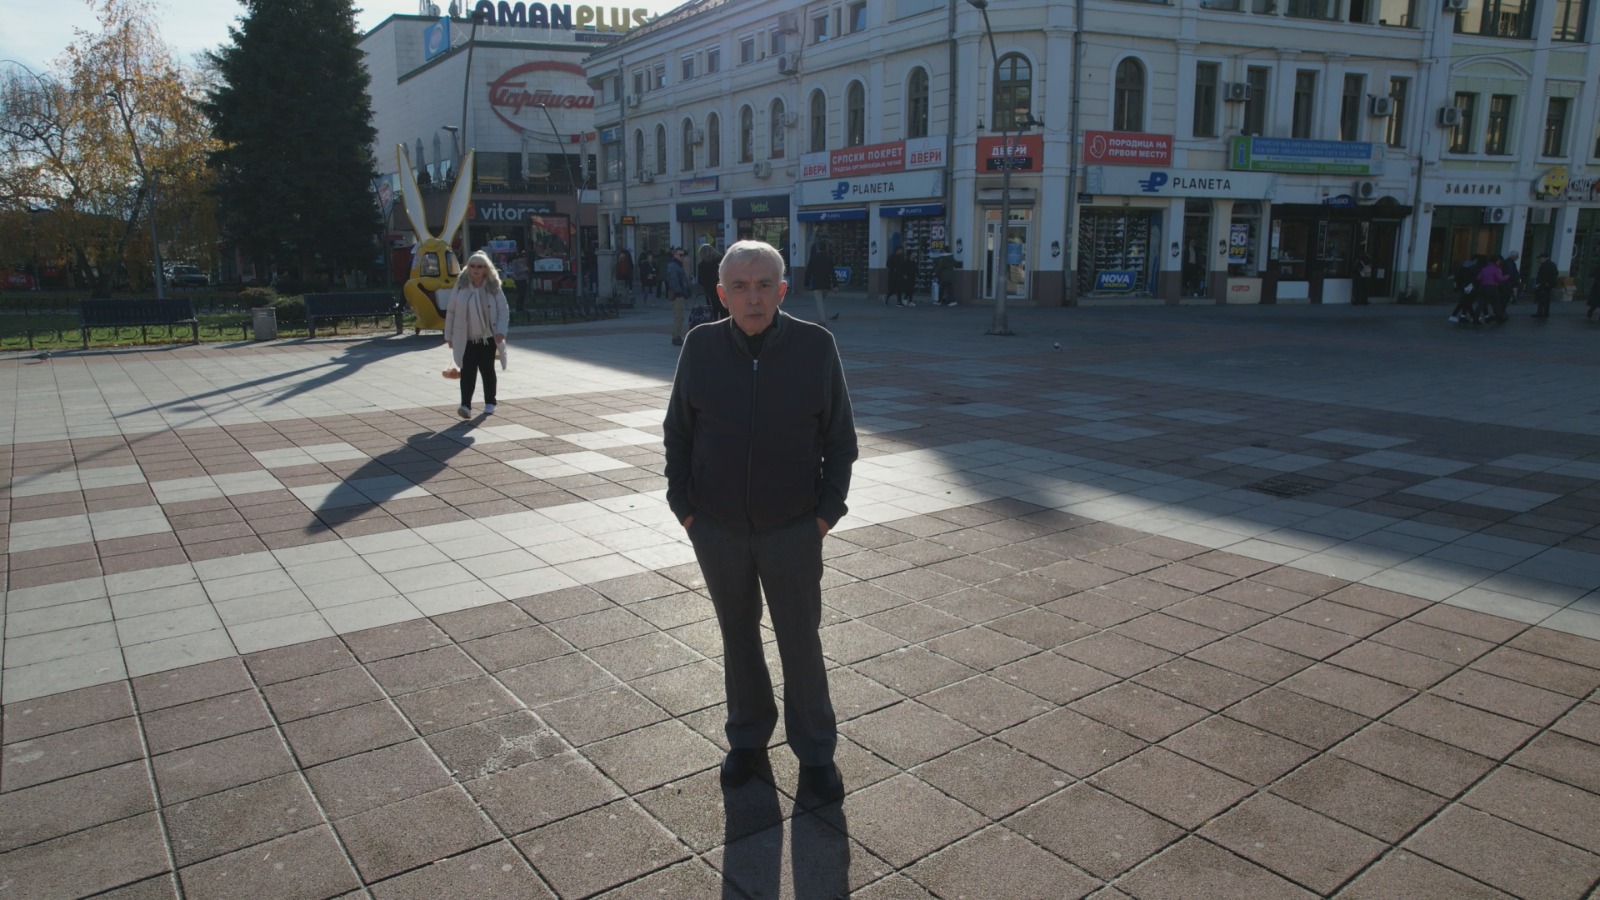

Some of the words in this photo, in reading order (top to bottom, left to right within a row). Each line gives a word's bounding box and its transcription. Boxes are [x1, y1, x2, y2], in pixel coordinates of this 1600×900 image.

[475, 0, 572, 30] AMAN
[576, 4, 648, 32] PLUS
[1109, 138, 1154, 149] ПОРОДИЦА
[1156, 141, 1167, 149] НА
[832, 152, 865, 164] СРПСКИ
[868, 147, 904, 160] ПОКРЕТ
[909, 150, 942, 164] ДВЕРИ
[991, 146, 1027, 156] ДВЕРИ
[1108, 149, 1137, 157] ПРВОМ
[1138, 150, 1167, 158] МЕСТУ!
[803, 164, 827, 177] ДВЕРИ
[852, 181, 894, 195] PLANETA
[1173, 177, 1231, 190] PLANETA
[1445, 183, 1501, 194] ЗЛАТАРА
[931, 225, 945, 240] 50
[931, 240, 945, 249] SVE
[1231, 232, 1247, 246] 50
[1230, 246, 1246, 255] SVE
[834, 270, 847, 278] OVA
[1102, 273, 1130, 283] NOVA
